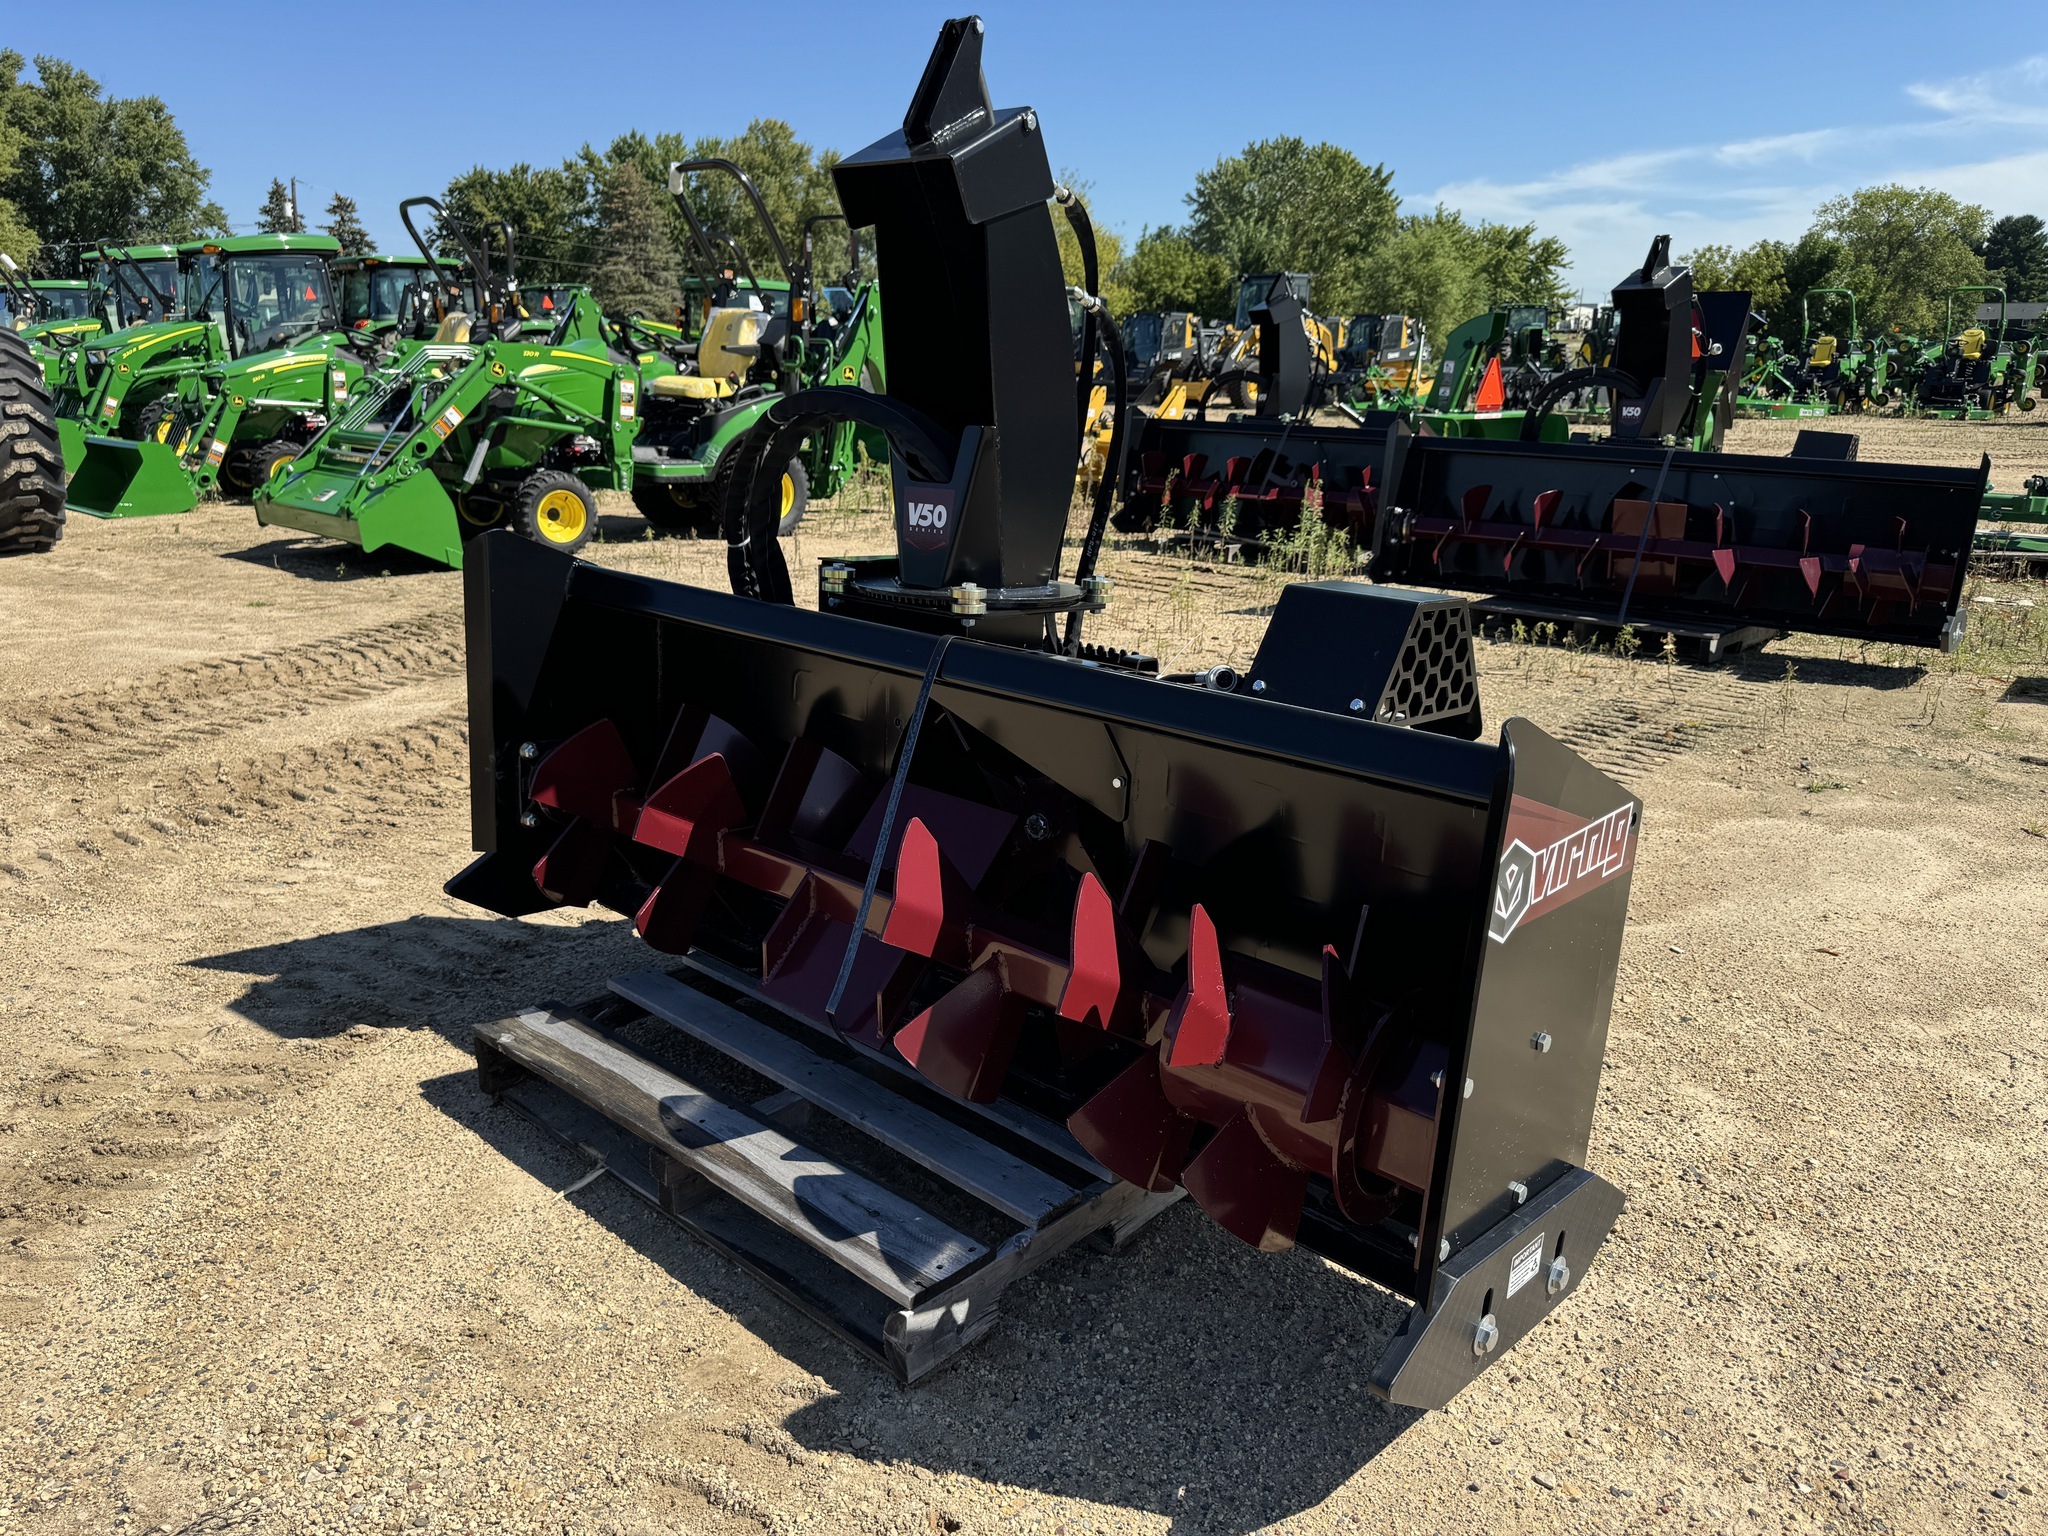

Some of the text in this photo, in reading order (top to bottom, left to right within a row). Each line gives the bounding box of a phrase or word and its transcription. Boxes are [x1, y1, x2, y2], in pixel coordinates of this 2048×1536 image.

[1622, 406, 1641, 416] V50
[908, 502, 948, 528] V50
[1513, 1238, 1542, 1268] IMPORTANT
